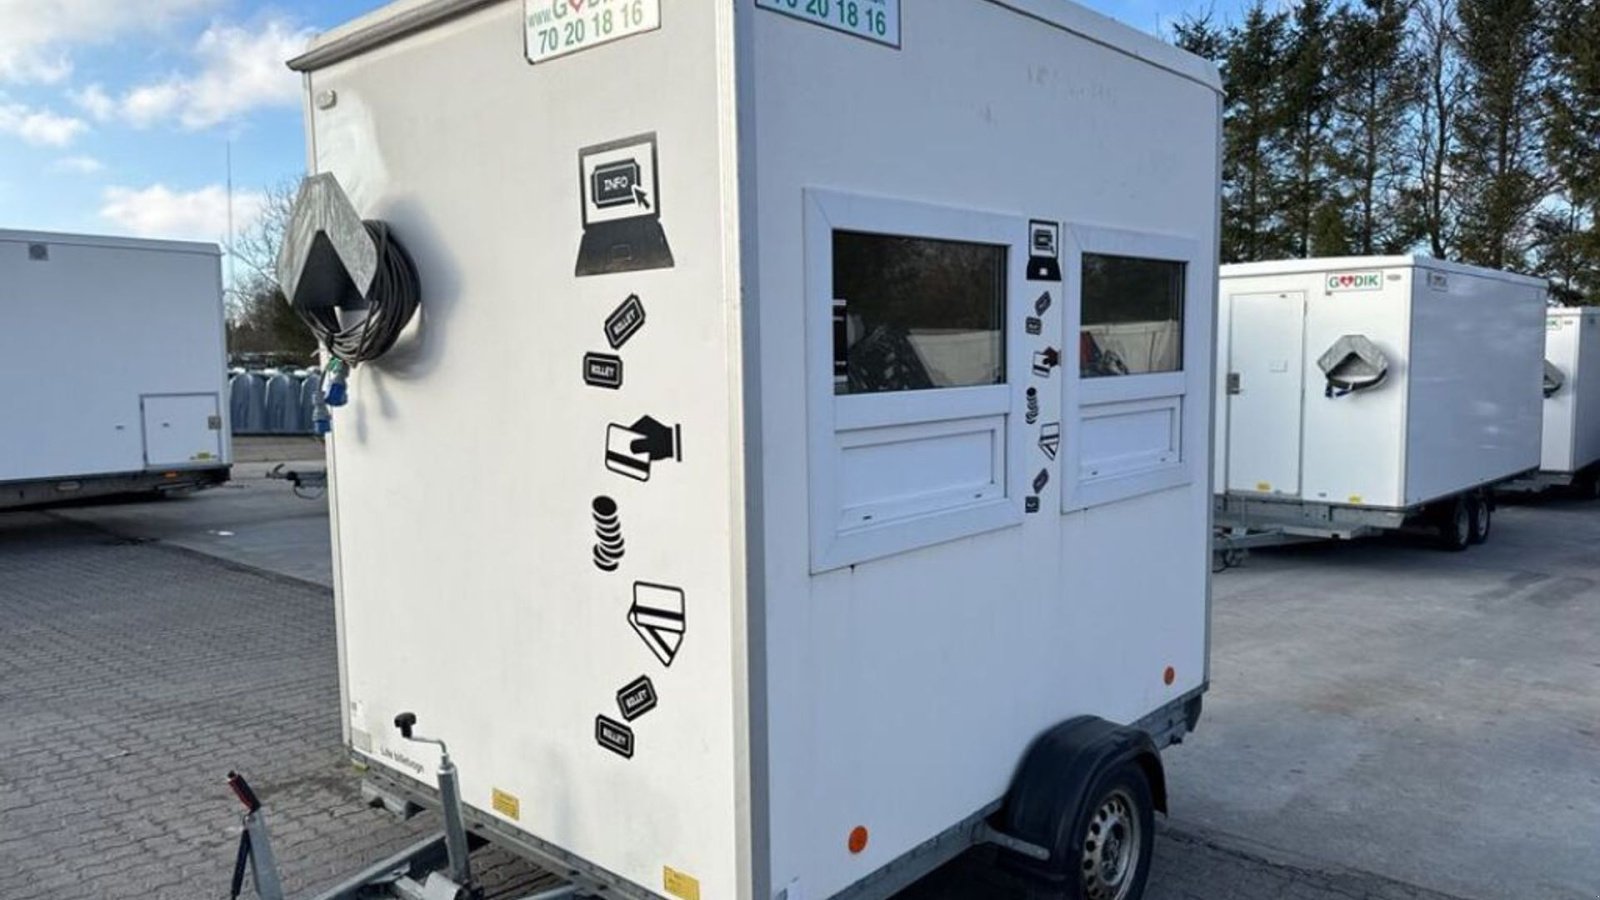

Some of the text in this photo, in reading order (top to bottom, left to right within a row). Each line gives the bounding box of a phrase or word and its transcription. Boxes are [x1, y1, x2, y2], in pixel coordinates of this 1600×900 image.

[538, 0, 643, 54] 70 20 18 16
[806, 0, 886, 36] 20 18 16
[604, 175, 628, 191] INFO
[591, 364, 615, 377] BILLET
